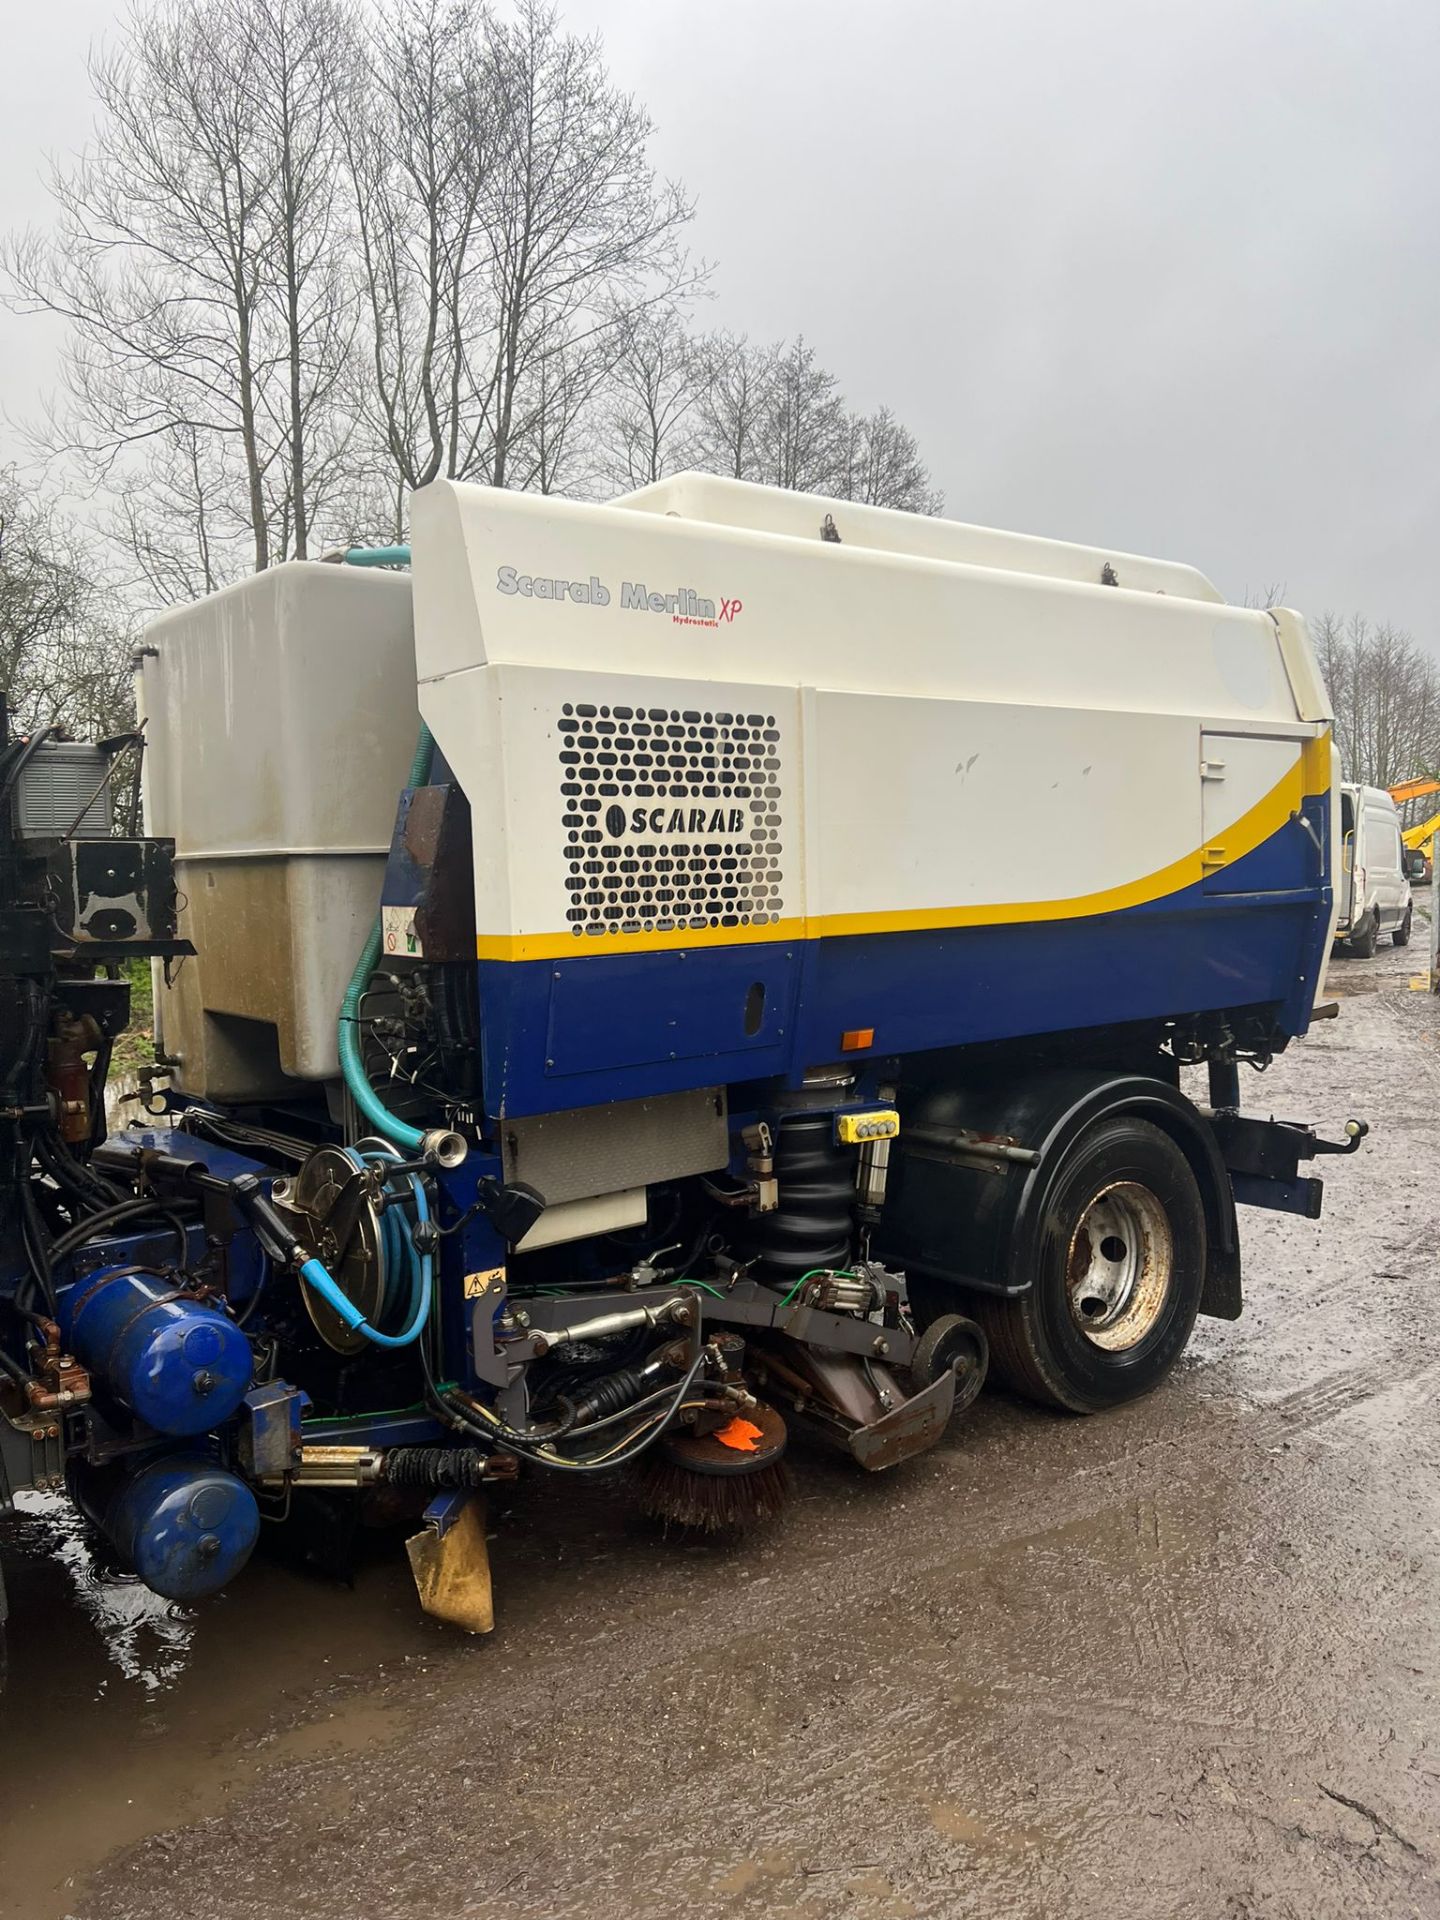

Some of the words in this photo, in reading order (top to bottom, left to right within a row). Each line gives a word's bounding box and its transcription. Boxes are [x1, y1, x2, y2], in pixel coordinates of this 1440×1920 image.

[497, 566, 610, 606] Scarab
[620, 582, 716, 619] Merlin
[719, 597, 743, 623] XP
[672, 614, 719, 628] Hydrostatic
[630, 808, 744, 833] SCARAB
